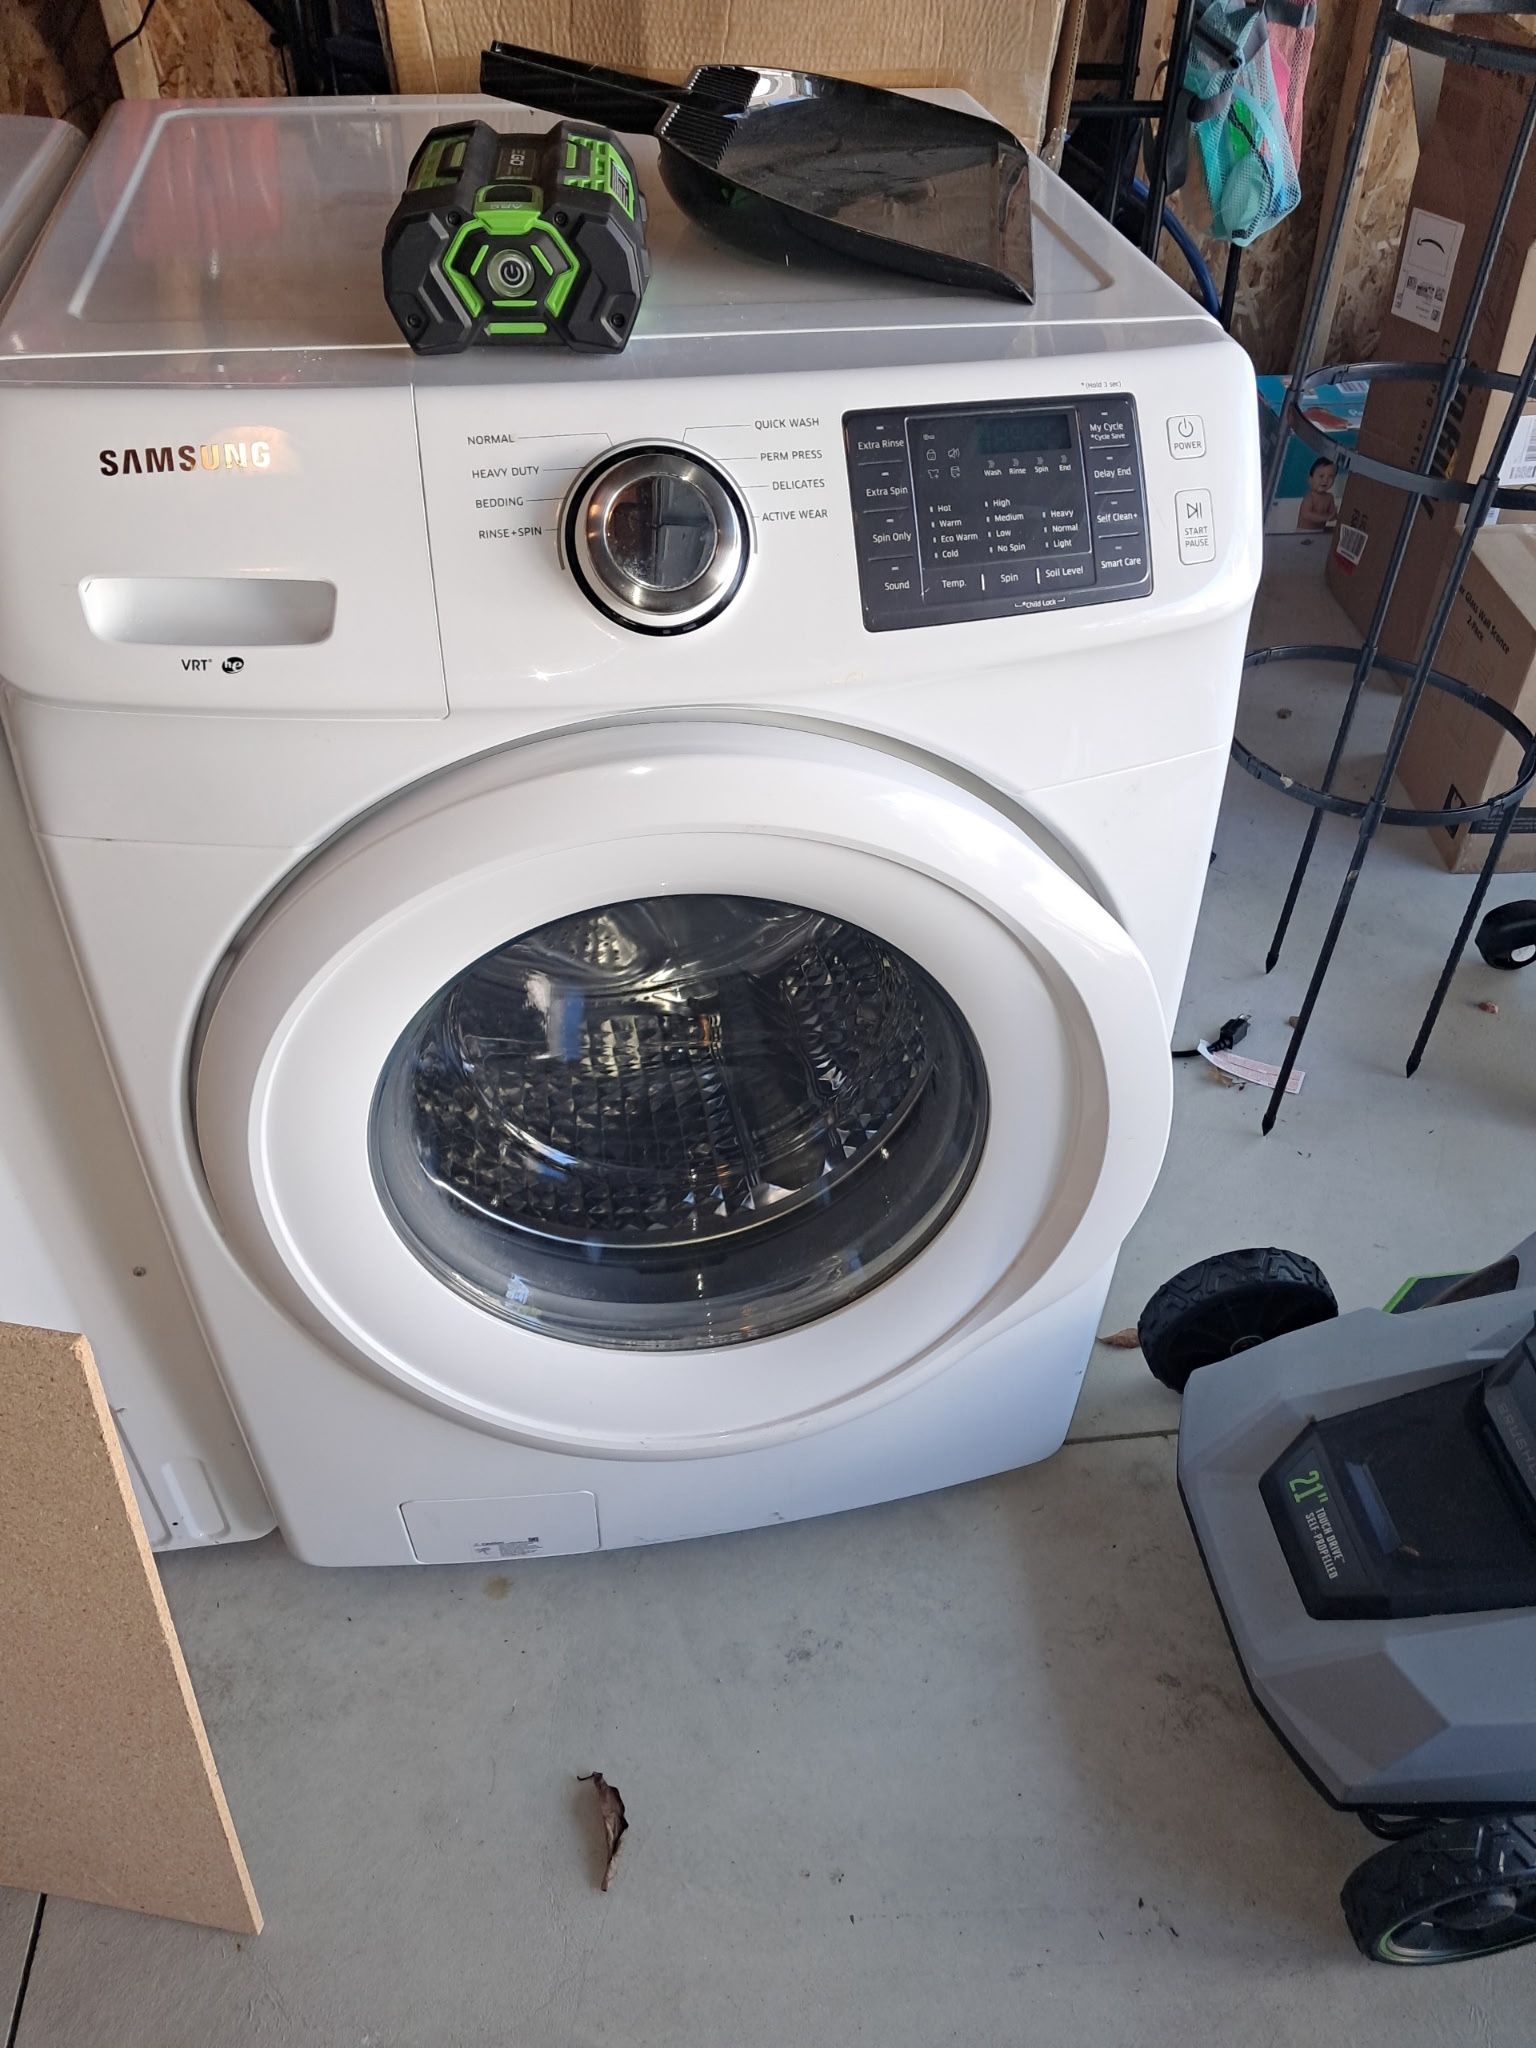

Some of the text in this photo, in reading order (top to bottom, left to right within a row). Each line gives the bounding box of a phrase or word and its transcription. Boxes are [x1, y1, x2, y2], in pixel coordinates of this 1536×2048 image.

[754, 417, 821, 431] QUICK WASH
[1089, 421, 1124, 433] My Cycle
[467, 434, 515, 446] NORMAL
[1111, 432, 1126, 440] Save
[858, 438, 905, 450] Extra Rinse
[1173, 440, 1202, 451] POWER
[99, 441, 271, 477] SAMSUNG
[760, 449, 823, 462] PERM PRESS
[472, 465, 540, 479] HEAVY DUTY
[984, 464, 1072, 477] Wash Rinse Spin End
[1094, 466, 1132, 479] Delay End
[772, 478, 825, 491] DELICATES
[866, 486, 909, 498] Extra Spin
[475, 496, 524, 509] BEDDING
[937, 503, 952, 513] Hot
[993, 498, 1011, 509] High
[762, 507, 829, 522] ACTIVE WEAR
[994, 512, 1025, 522] Medium
[1050, 509, 1075, 519] Heavy
[1096, 513, 1111, 524] Self
[939, 518, 963, 528] Warm
[1052, 523, 1079, 533] Normal
[996, 529, 1012, 538] Low
[1184, 525, 1208, 536] START
[872, 531, 912, 544] Spin Only
[940, 533, 979, 543] Eco Warm
[1185, 537, 1209, 548] PAUSE
[997, 542, 1026, 553] No Spin
[1053, 539, 1073, 549] Light
[942, 549, 960, 559] Cold
[1101, 556, 1142, 569] Smart Care
[1000, 571, 1019, 584] Spin
[1045, 564, 1084, 579] Soil Level
[884, 580, 910, 591] Sound
[941, 579, 967, 591] Temp.
[1042, 598, 1057, 607] Lock
[1289, 1470, 1329, 1504] 21"
[1315, 1506, 1333, 1536] TOUCH
[1305, 1512, 1339, 1580] SELF-PROPELLED
